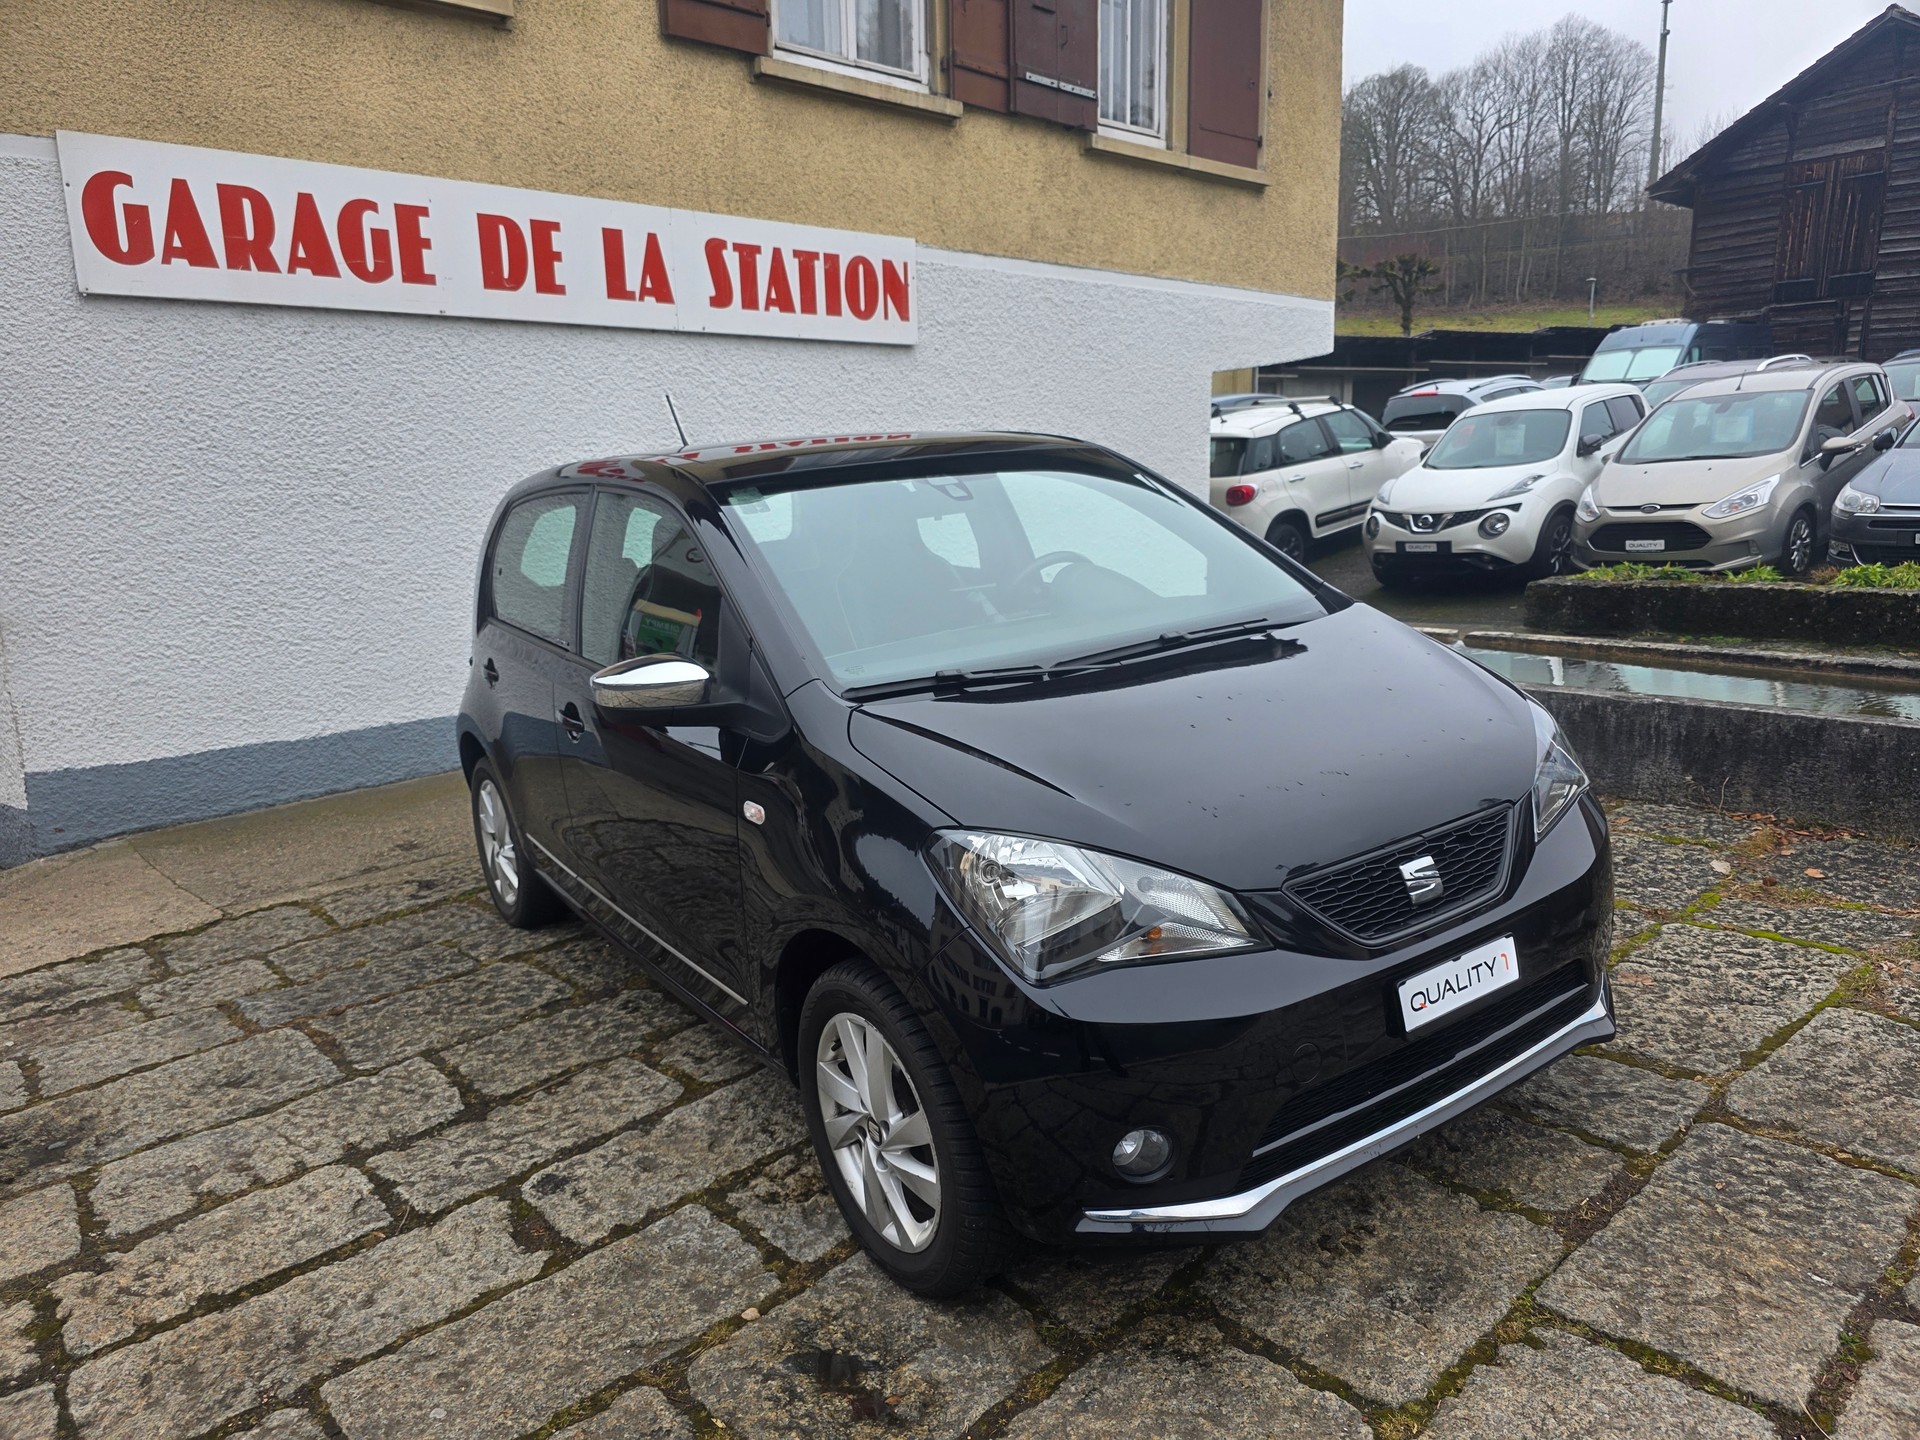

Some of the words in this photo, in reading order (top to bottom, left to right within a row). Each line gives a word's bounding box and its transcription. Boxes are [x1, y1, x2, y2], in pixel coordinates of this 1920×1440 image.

[83, 171, 436, 285] GARAGE
[478, 213, 566, 296] DE
[603, 227, 673, 304] LA
[705, 238, 910, 322] STATION
[1410, 956, 1497, 1012] QUALITY
